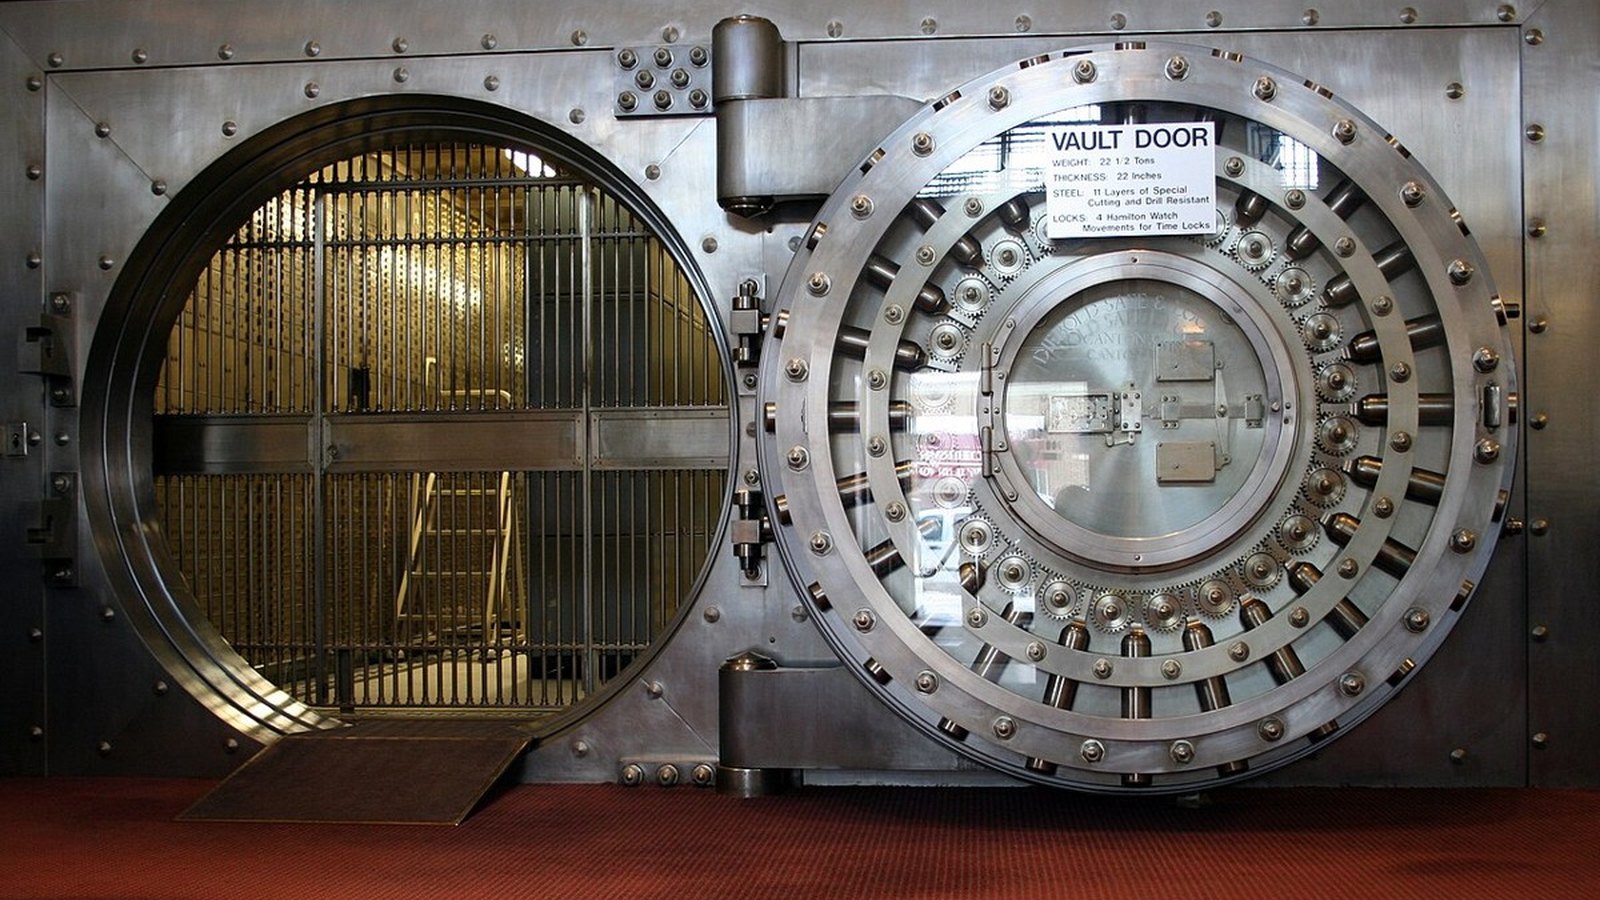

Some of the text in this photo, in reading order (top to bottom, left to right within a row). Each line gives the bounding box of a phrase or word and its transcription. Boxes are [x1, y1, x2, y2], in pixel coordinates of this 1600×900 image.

[1052, 128, 1208, 151] VAULT DOOR
[1052, 157, 1155, 167] WEIGHT: 22 1/2 Tons
[1117, 173, 1128, 181] 22
[1132, 171, 1162, 180] Inches
[1053, 186, 1187, 198] STEEL: 11 Layers of Special
[1088, 195, 1209, 208] Cutting and Drill Resistant
[1107, 212, 1146, 221] Hamilton
[1150, 212, 1178, 220] Watch
[1082, 221, 1210, 232] Movements for Time Locks
